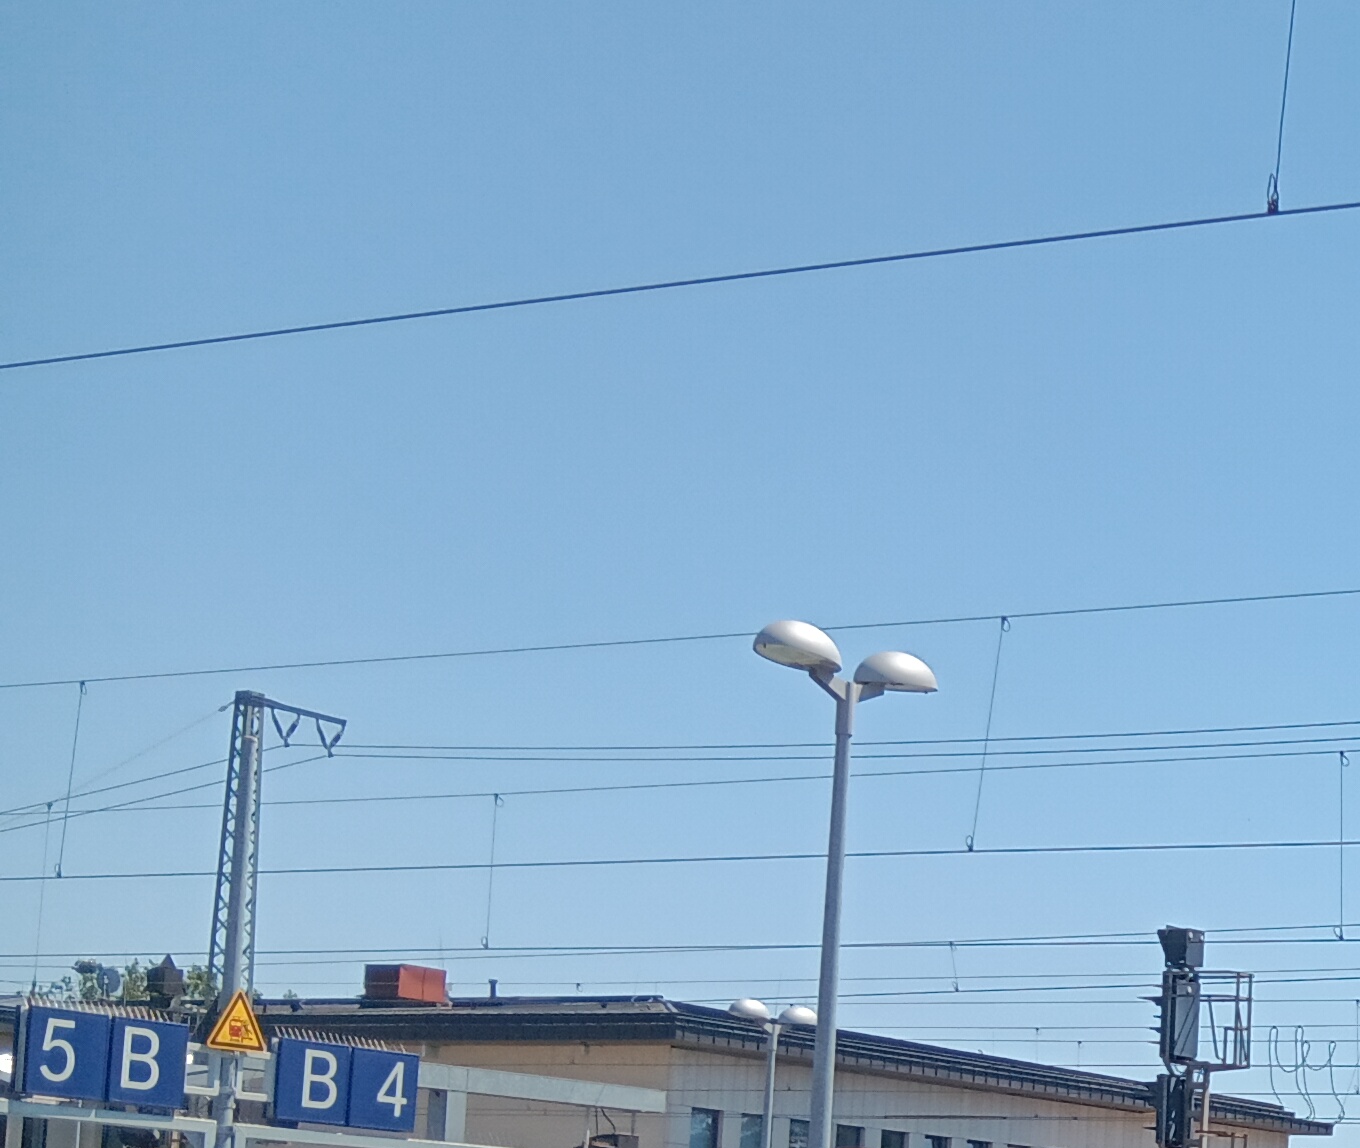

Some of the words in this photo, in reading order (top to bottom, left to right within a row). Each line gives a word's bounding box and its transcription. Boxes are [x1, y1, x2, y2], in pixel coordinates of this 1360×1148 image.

[41, 1019, 76, 1082] 5
[119, 1025, 160, 1090] B
[302, 1048, 338, 1108] B
[376, 1061, 408, 1118] 4
